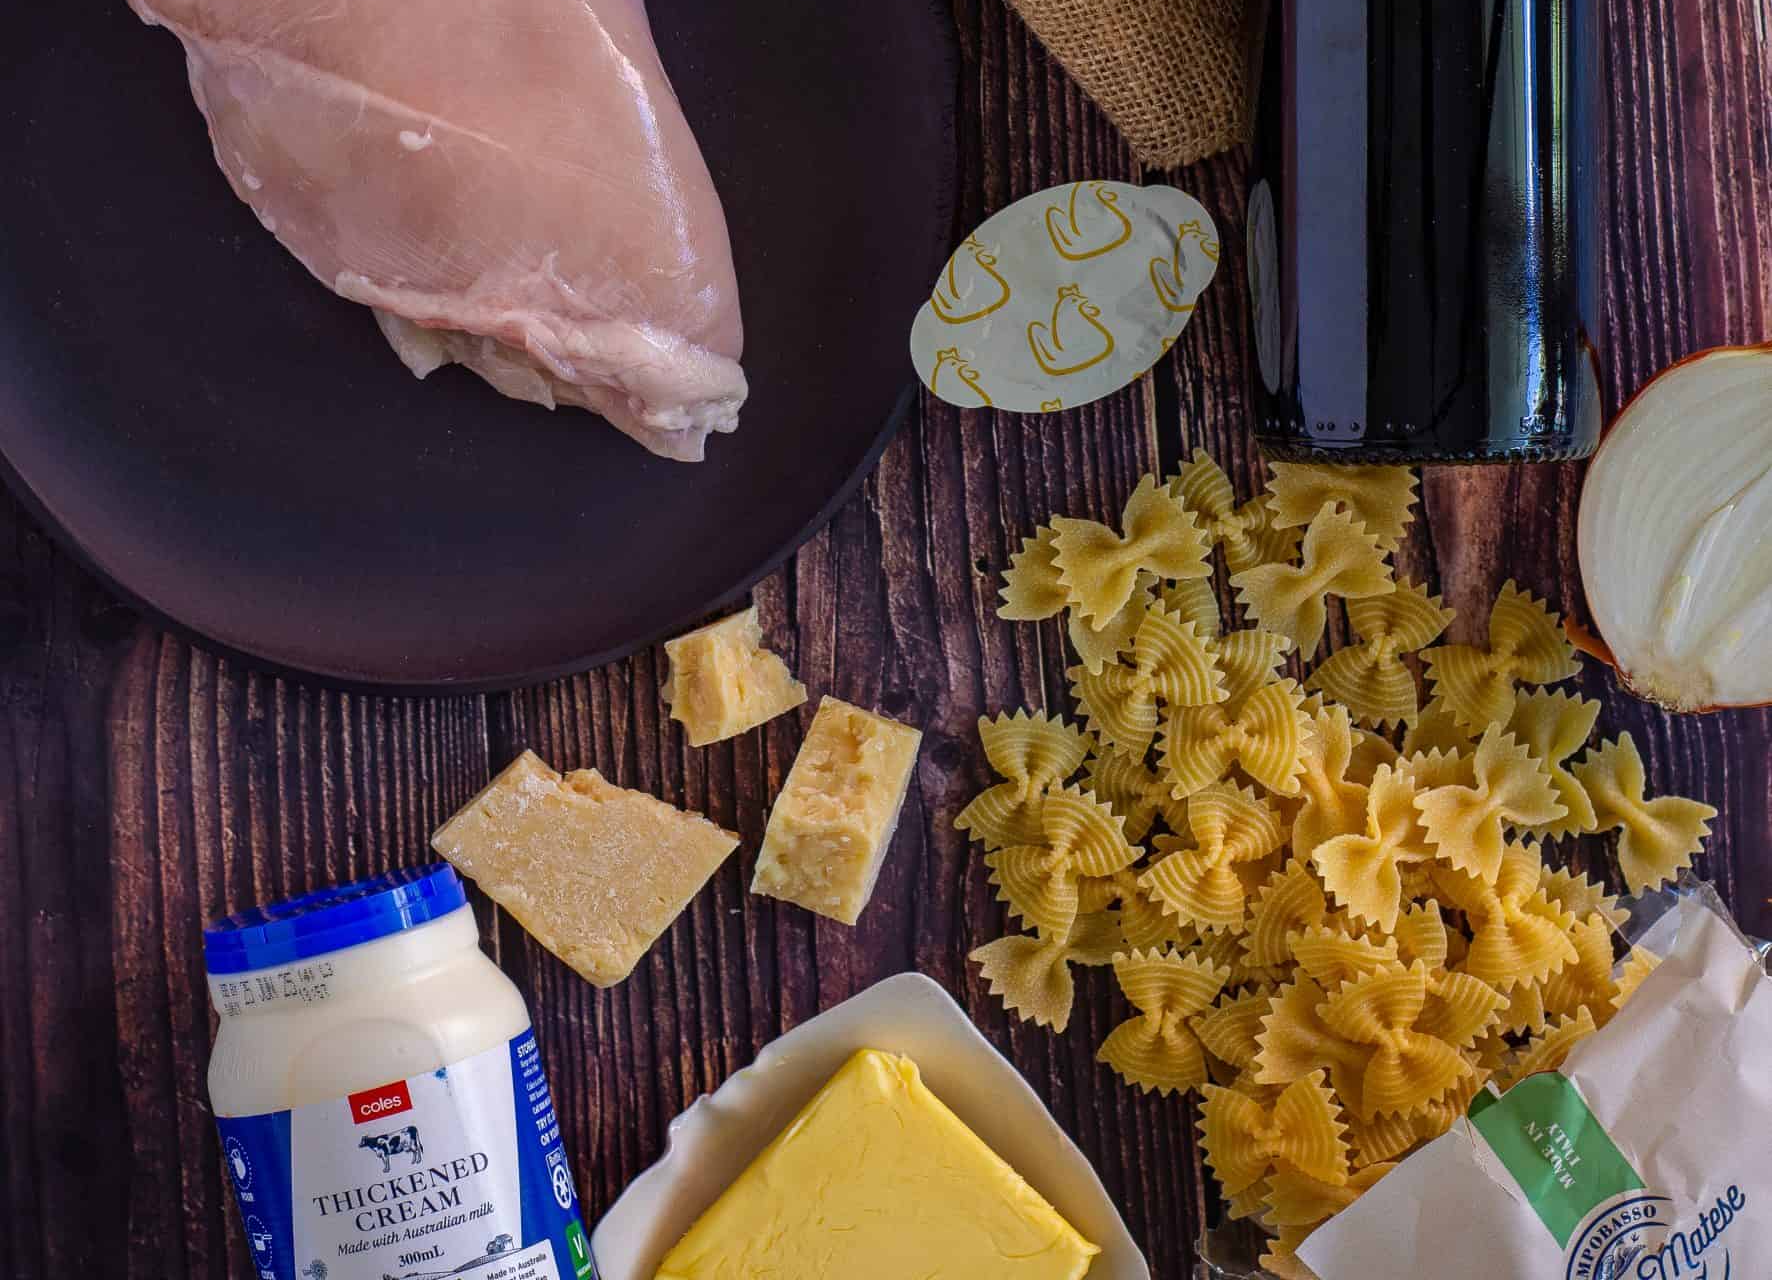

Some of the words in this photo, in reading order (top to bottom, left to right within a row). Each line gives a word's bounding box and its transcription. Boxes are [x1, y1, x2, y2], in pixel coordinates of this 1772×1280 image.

[360, 1095, 402, 1116] coles
[312, 1151, 489, 1217] THICKENED
[355, 1185, 463, 1232] CREAM
[338, 1240, 371, 1257] Made
[372, 1231, 400, 1249] with
[402, 1213, 467, 1242] Australian
[469, 1201, 495, 1221] milk
[1575, 1204, 1657, 1280] MPOBASSO
[1637, 1184, 1746, 1280] Matese
[398, 1244, 445, 1268] 300mL
[517, 1253, 547, 1269] Australia
